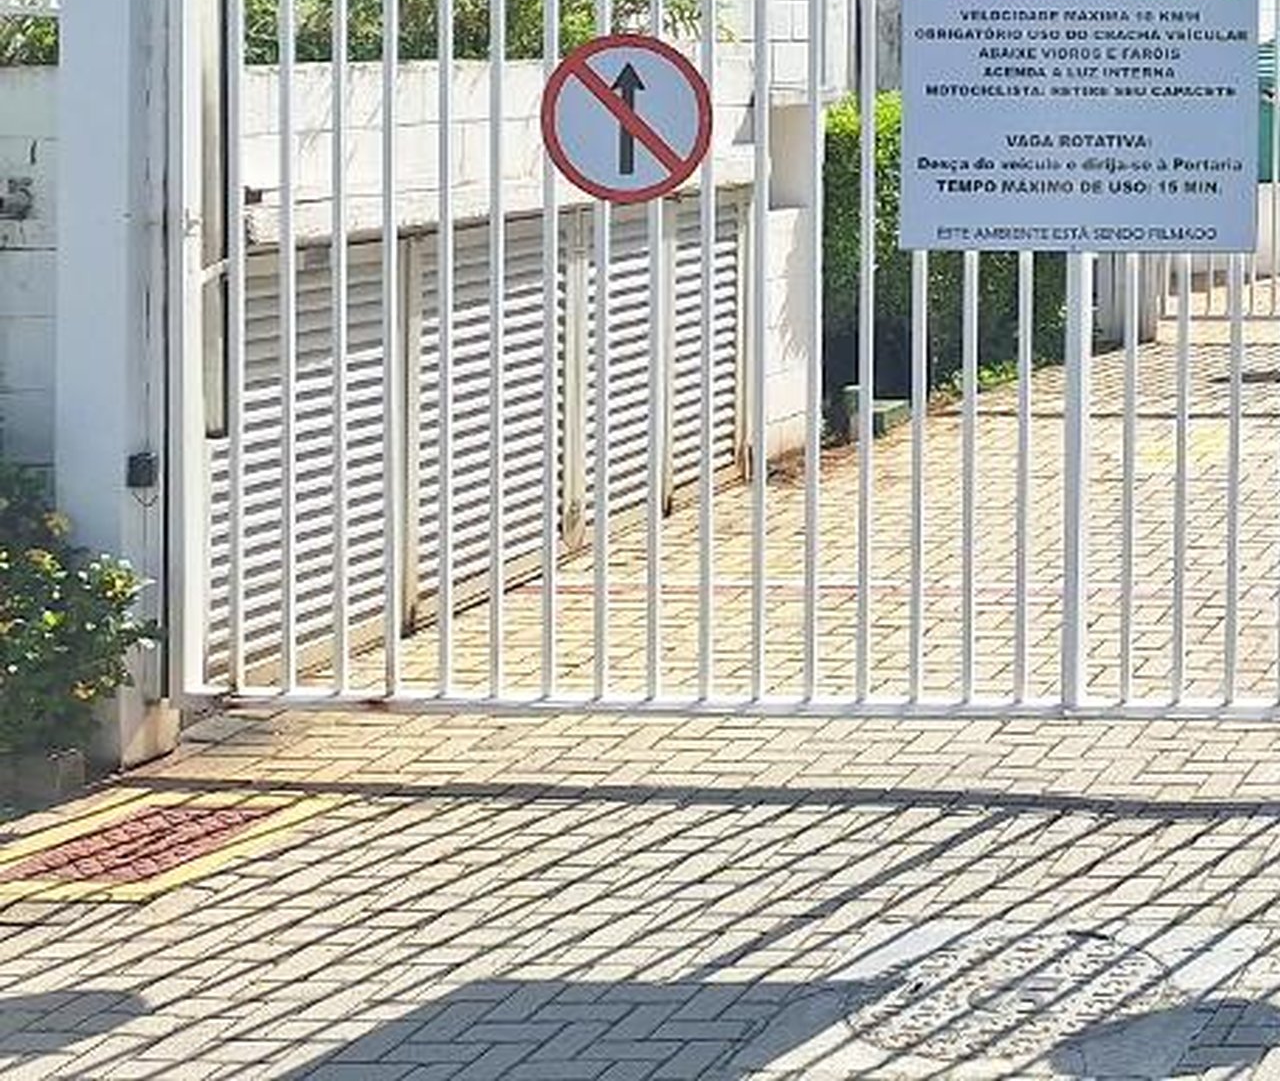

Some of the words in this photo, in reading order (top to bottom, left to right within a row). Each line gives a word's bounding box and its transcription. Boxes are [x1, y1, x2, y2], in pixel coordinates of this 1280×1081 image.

[960, 10, 1059, 21] VELOCIDADE
[1027, 29, 1060, 40] USO
[1065, 29, 1089, 40] DO
[979, 47, 1037, 59] ABAIXE
[1041, 47, 1102, 59] VIDROS
[1106, 47, 1117, 59] E
[983, 66, 1046, 78] ACENDA
[1067, 66, 1099, 78] LUZ
[1103, 66, 1175, 78] INTERNA
[1050, 86, 1108, 97] RETIRE
[1114, 86, 1147, 97] SEU
[1151, 86, 1237, 97] CAPACETE
[1006, 134, 1054, 148] VAGA
[917, 156, 970, 172] Desça
[973, 156, 995, 170] do
[1066, 159, 1077, 171] e
[1173, 157, 1243, 171] Portaria
[936, 179, 997, 193] TEMPO
[1080, 180, 1103, 194] DE
[1159, 180, 1178, 194] 15
